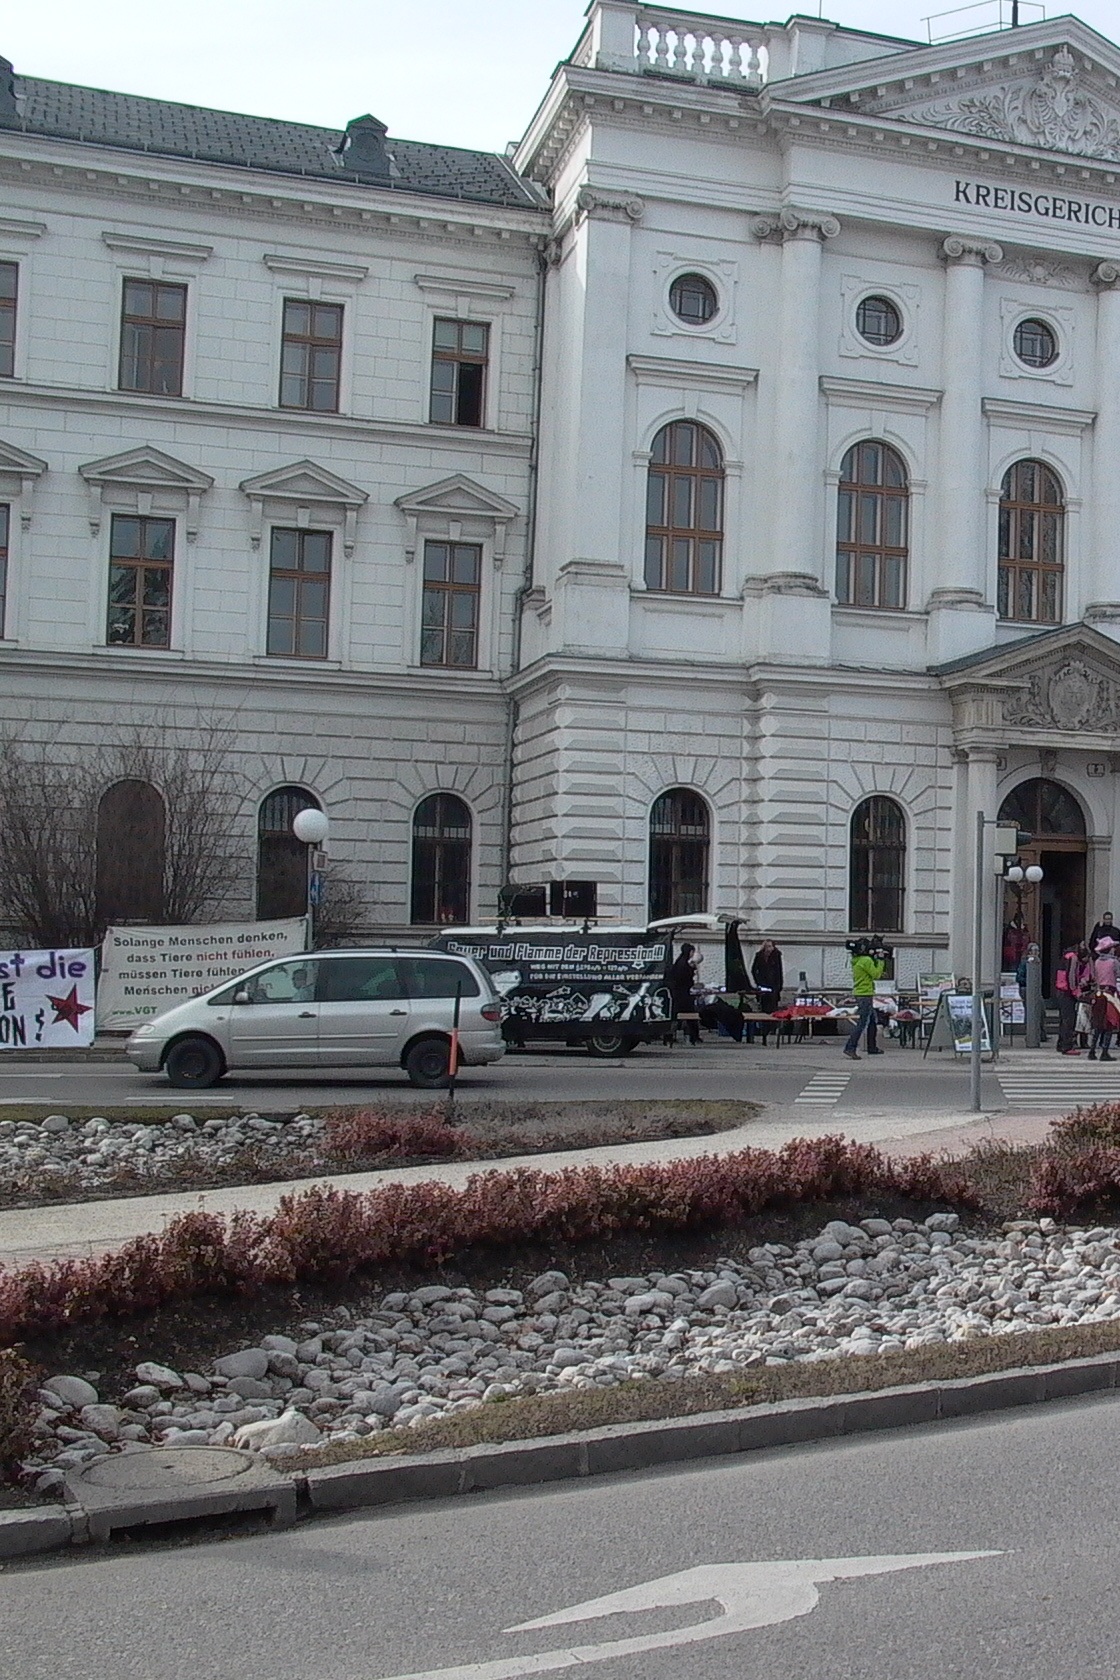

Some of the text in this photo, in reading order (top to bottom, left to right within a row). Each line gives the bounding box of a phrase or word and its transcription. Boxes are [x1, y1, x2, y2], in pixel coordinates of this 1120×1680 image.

[113, 930, 288, 949] Solange Menschen denken,
[126, 953, 156, 964] dass
[159, 952, 192, 963] Tiere
[196, 951, 228, 962] nicht
[488, 943, 514, 960] und
[514, 942, 563, 961] Flamme
[563, 944, 586, 961] der
[36, 951, 87, 980] die
[118, 968, 167, 980] müssen
[170, 968, 203, 978] Tiere
[124, 985, 188, 996] Menschen
